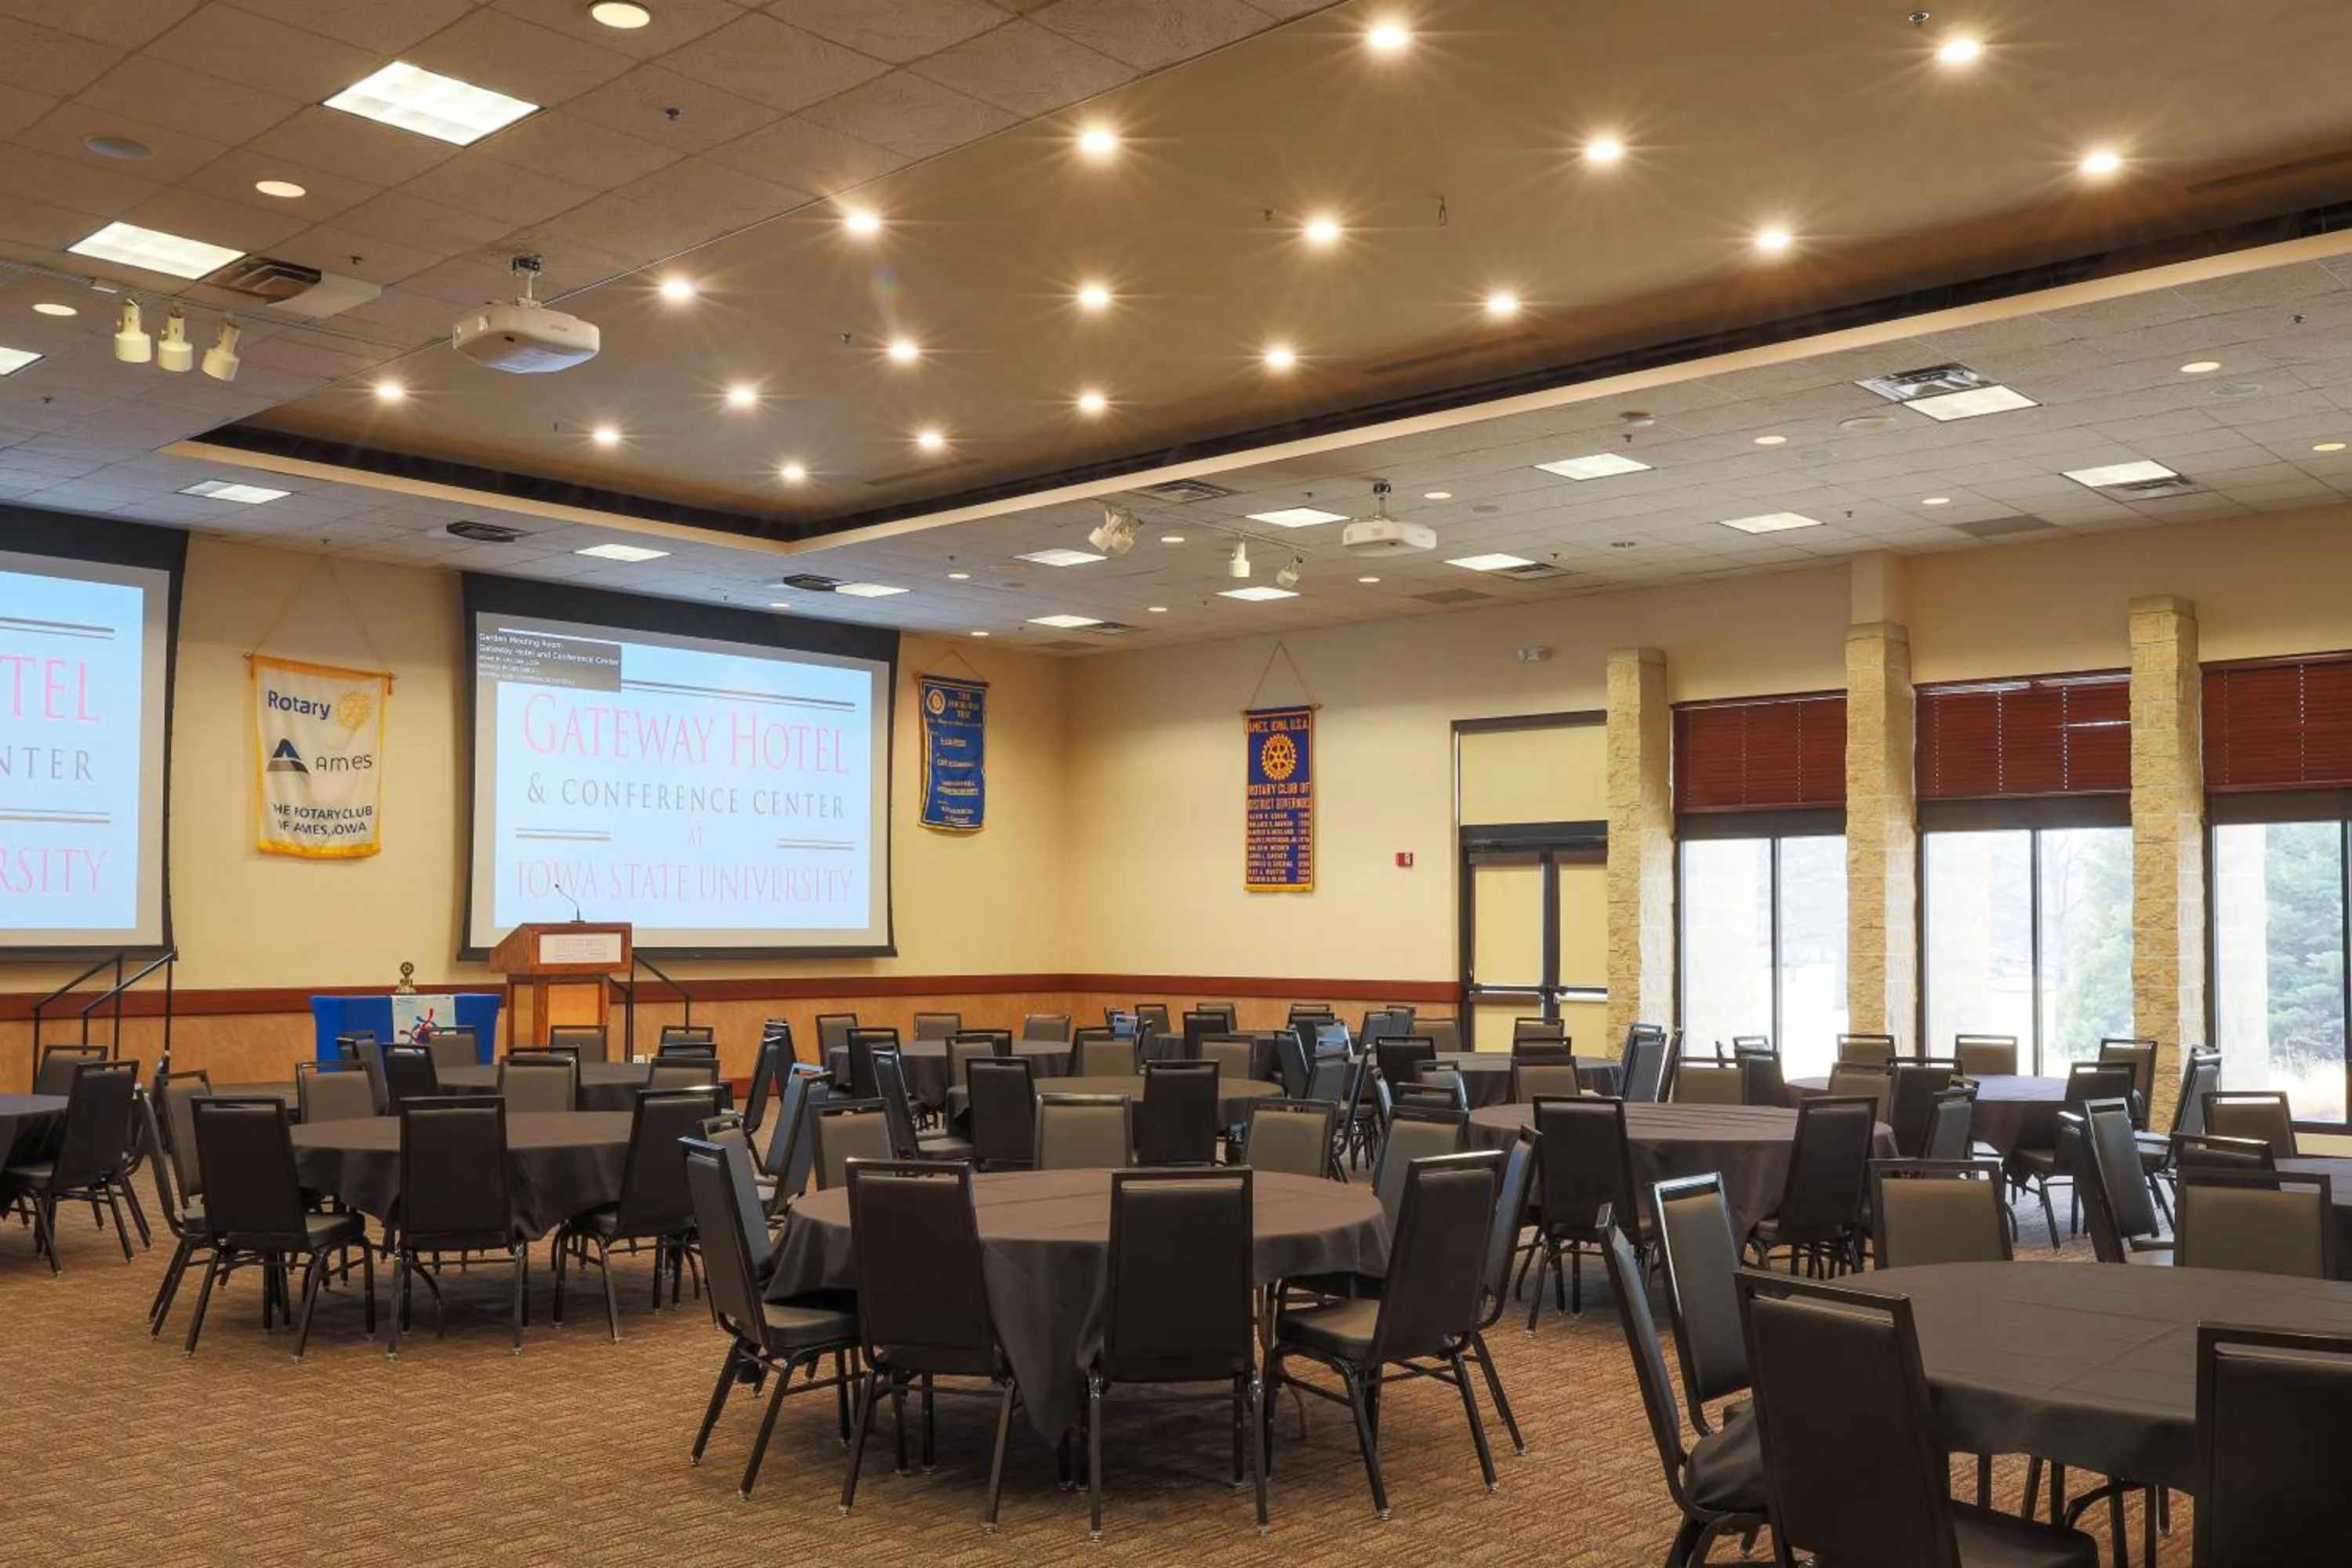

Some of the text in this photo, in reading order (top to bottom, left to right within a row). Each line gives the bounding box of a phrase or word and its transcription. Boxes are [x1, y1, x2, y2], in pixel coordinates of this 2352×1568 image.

[267, 690, 331, 720] Rotary
[524, 692, 848, 774] GATEWAY HOTEL
[271, 803, 290, 816] HE
[342, 805, 372, 819] CLUB
[528, 772, 844, 818] & CONFERENCE CENTER
[517, 860, 852, 903] IOWA STATE UNIVERSITY
